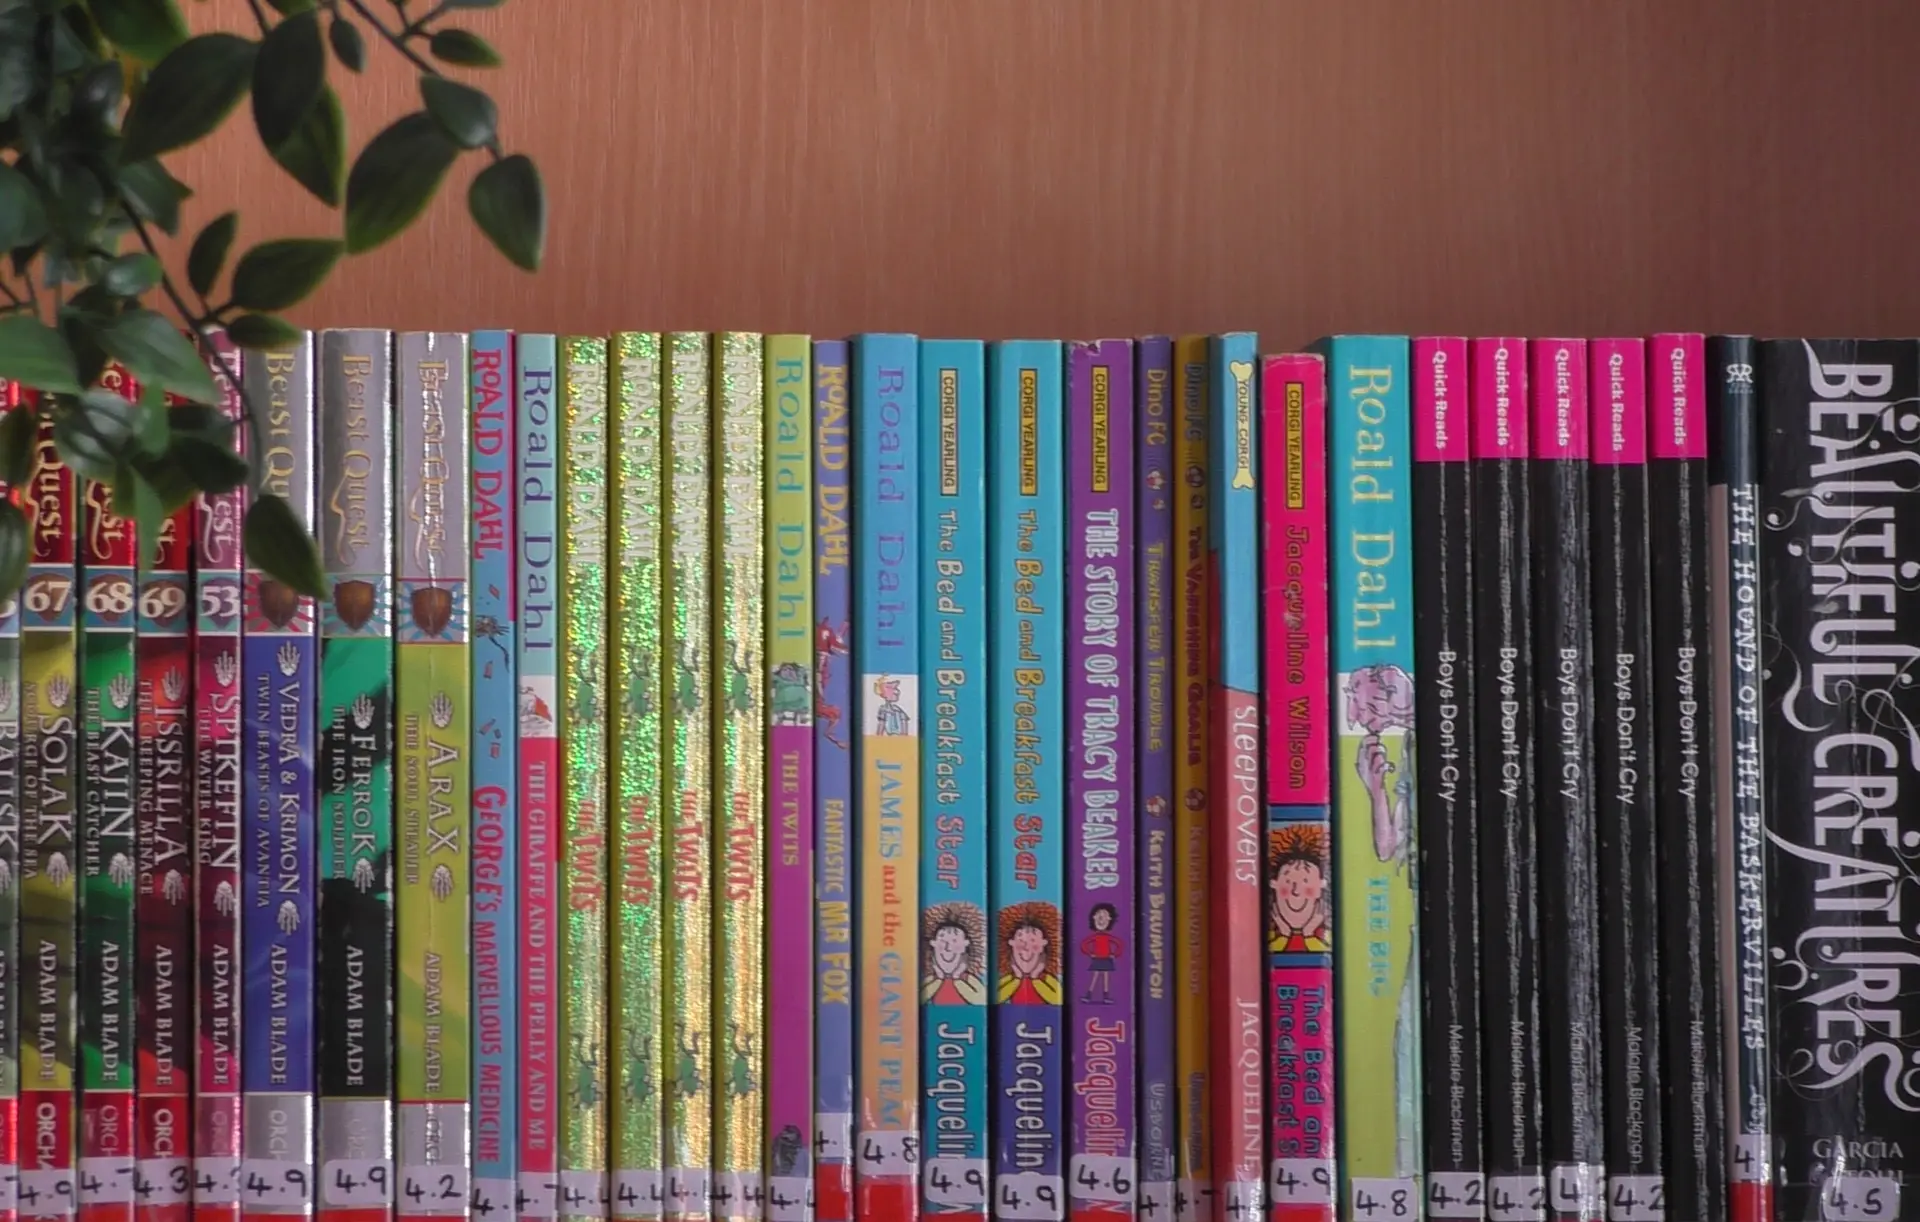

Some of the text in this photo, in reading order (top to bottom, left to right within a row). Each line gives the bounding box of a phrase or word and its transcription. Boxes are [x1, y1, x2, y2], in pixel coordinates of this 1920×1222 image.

[264, 351, 297, 437] Beast
[332, 353, 374, 566] Beast Quest
[472, 348, 505, 560] ROALD DAHL
[943, 375, 956, 488] CORGI YEARLING
[1093, 373, 1107, 485] CORGI YEARLING
[1146, 368, 1168, 446] Dino FC
[1237, 378, 1251, 471] YOUNG CORGI
[1287, 388, 1302, 502] CORGI YEARLING
[1432, 350, 1449, 450] Quick Reads
[1494, 347, 1511, 447] Quick Reads
[1555, 348, 1572, 447] Quick Reads
[1608, 352, 1626, 452] Quick Reads
[523, 365, 554, 653] Roald Dahl
[775, 356, 805, 640] Roald Dahl
[818, 363, 848, 577] ROALD DAHL
[878, 364, 906, 648] Roald Dahl
[1348, 362, 1398, 653] Roald Dahl
[1803, 339, 1900, 706] BEAUTIFUL
[24, 580, 72, 613] 67
[86, 582, 134, 614] 68
[138, 586, 188, 618] 69
[201, 585, 239, 618] 53
[1283, 524, 1312, 791] Jacqueline Wilson
[936, 507, 966, 891] The Bed and Breakfast Star
[1014, 507, 1045, 891] The Bed and Breakfast Star
[1082, 507, 1120, 890] THE STORY OF TRACY BEAKER
[1435, 649, 1460, 803] Boys Don't Cry
[1496, 645, 1521, 800] Boys Don't Cry
[1557, 647, 1582, 800] Boys Don't Cry
[1612, 652, 1639, 805] Boys Don't Cry
[1730, 483, 1766, 1050] THE HOUND OF THE BASKERVILLES
[38, 714, 75, 845] SOLAK
[86, 687, 101, 877] THE BEAST CATCHER
[98, 719, 134, 838] KAJIN
[139, 680, 154, 896] THE CREEPING MENACE
[153, 703, 189, 867] ISSRILLA
[198, 748, 212, 866] WATER KING
[210, 692, 241, 869] SPIKEFIN
[256, 674, 270, 908] TWIN BEASTS AVANTIA
[278, 681, 301, 896] VEDRA KRIMON
[332, 706, 347, 880] THE IRON SOLDIER
[351, 732, 377, 857] FERROK
[405, 756, 420, 886] SOUL STEALER
[426, 738, 460, 856] ARAX
[781, 750, 800, 867] THE TWITS
[528, 761, 547, 1152] THE GIRAFFE AND THE PELLY AND ME
[818, 799, 849, 1005] FANTASTIC MR FOX
[878, 758, 904, 1051] JAMES and the GIANT
[1795, 733, 1908, 1112] CREATURES
[39, 940, 55, 1080] ADAM BLADE
[101, 940, 119, 1082] ADAM BLADE
[270, 943, 288, 1084] ADAM BLADE
[346, 944, 363, 1086] ADAM BLADE
[425, 952, 442, 1093] ADAM BLADE
[472, 784, 507, 1162] GEORGE'S MARVELLOUS MEDICINE
[1005, 1022, 1054, 1168] Jacquelin
[1235, 997, 1261, 1168] JACQUELINE
[1276, 983, 1300, 1129] Breakfast
[1302, 983, 1325, 1106] The Bed
[1447, 1023, 1466, 1163] Malorie Blackman
[247, 1168, 307, 1197] 4.9
[336, 1167, 387, 1195] 4.9
[405, 1174, 461, 1204] 4.2
[931, 1167, 985, 1196] 4.9
[1002, 1184, 1056, 1212] 4.9
[1077, 1163, 1131, 1195] 4.6
[1355, 1186, 1408, 1218] 4.8
[1431, 1180, 1482, 1210] 4.2
